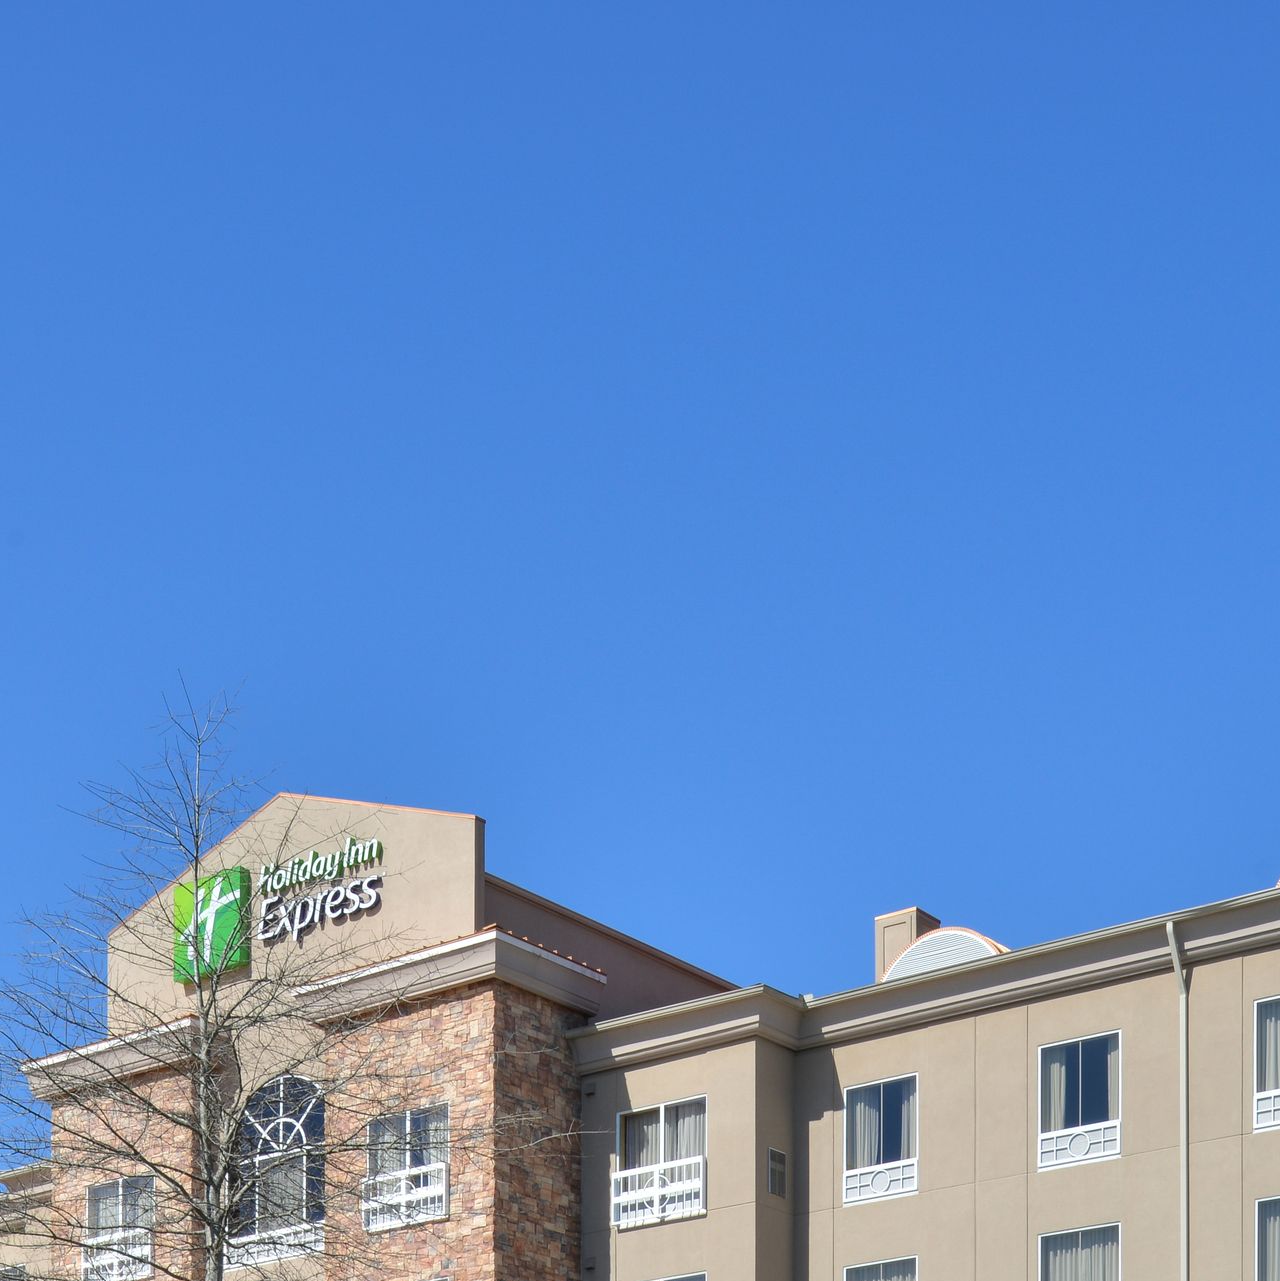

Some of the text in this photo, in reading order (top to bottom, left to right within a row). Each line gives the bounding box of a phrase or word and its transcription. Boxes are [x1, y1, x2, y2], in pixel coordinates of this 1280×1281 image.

[256, 837, 379, 896] Holiday Inn
[256, 874, 380, 942] Express
